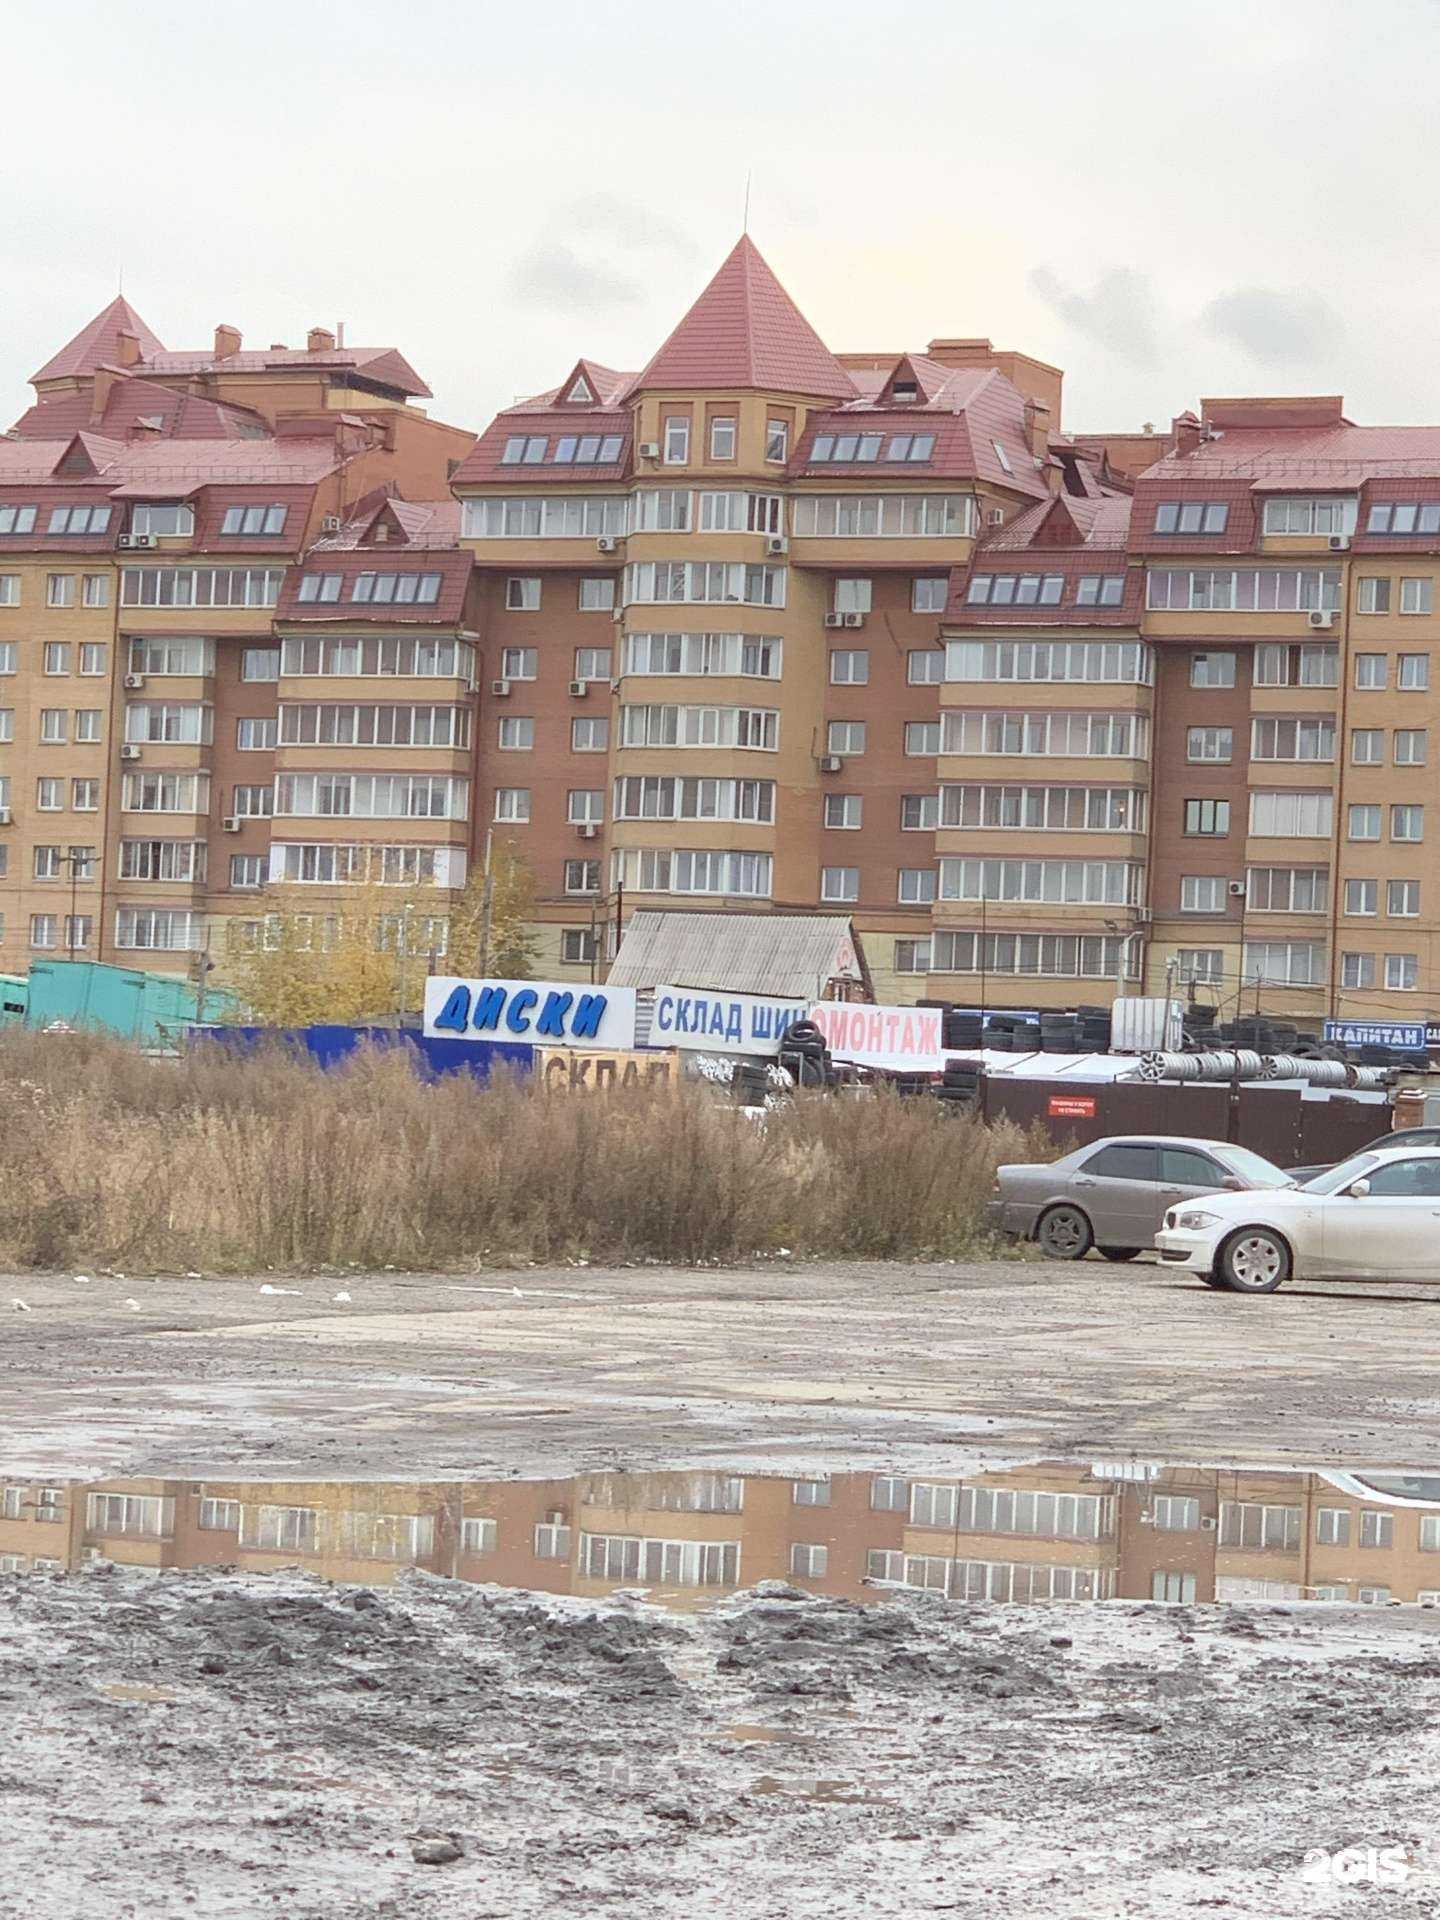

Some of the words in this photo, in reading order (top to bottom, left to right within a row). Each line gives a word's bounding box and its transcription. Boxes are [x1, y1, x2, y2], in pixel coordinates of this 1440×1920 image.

[434, 985, 608, 1038] ДИСКИ
[658, 996, 742, 1043] СКЛАД
[1331, 1027, 1417, 1044] КАПИТАН
